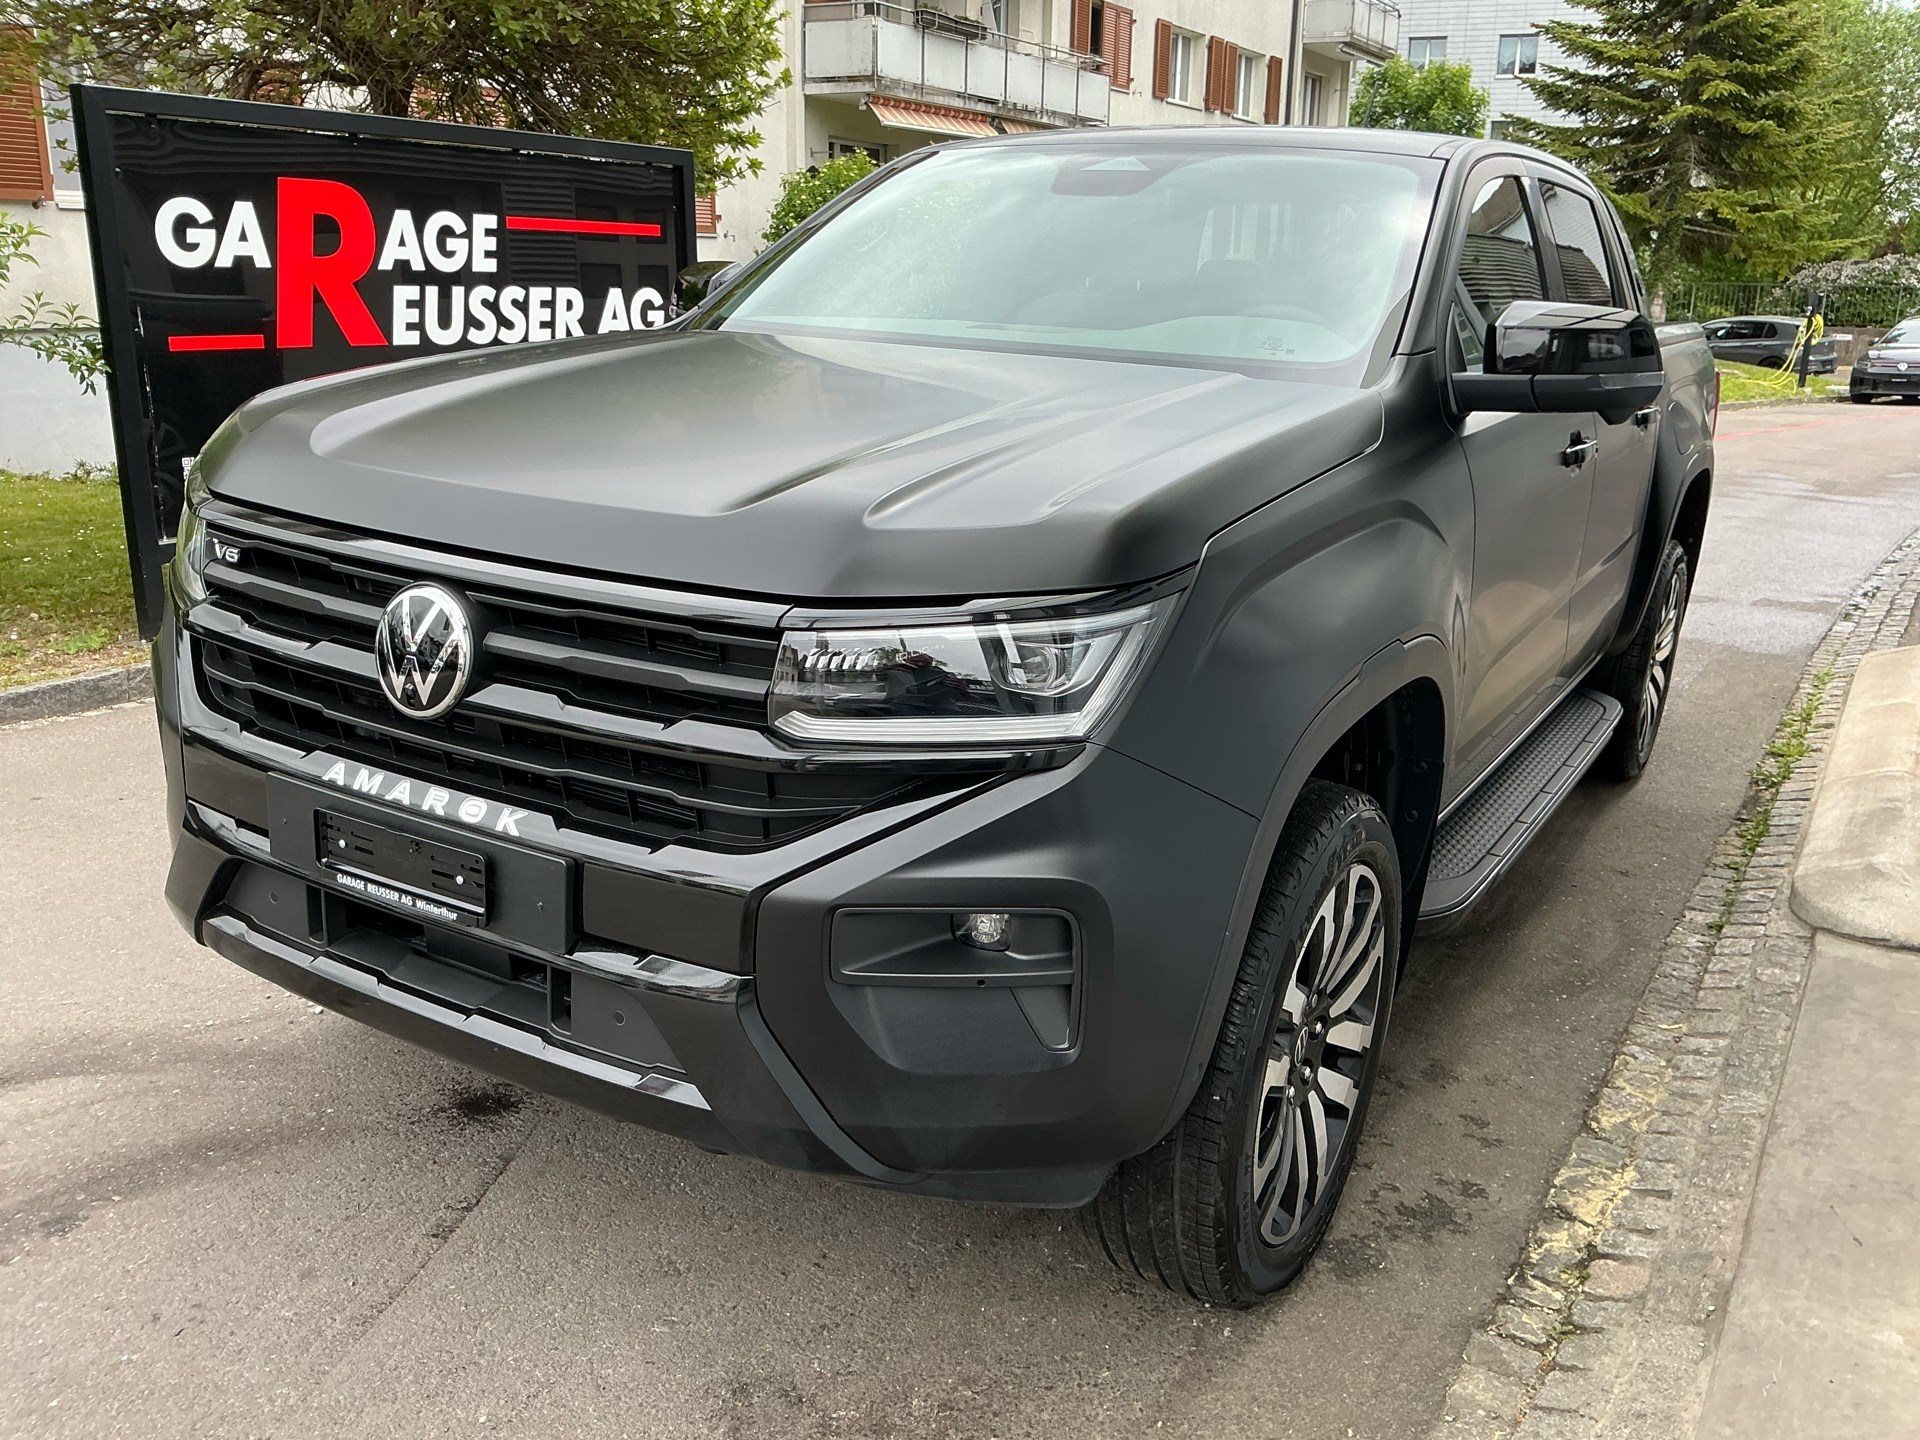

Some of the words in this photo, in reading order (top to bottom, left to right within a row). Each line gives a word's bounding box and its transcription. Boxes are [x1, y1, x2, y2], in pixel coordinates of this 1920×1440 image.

[154, 176, 498, 348] GARAGE
[597, 286, 665, 335] AG
[212, 537, 239, 563] V6
[321, 760, 529, 837] AMAROK
[336, 873, 365, 891] GARAGE
[367, 882, 400, 902] REUSSER
[401, 895, 413, 906] AG
[415, 899, 458, 920] Winterthur
